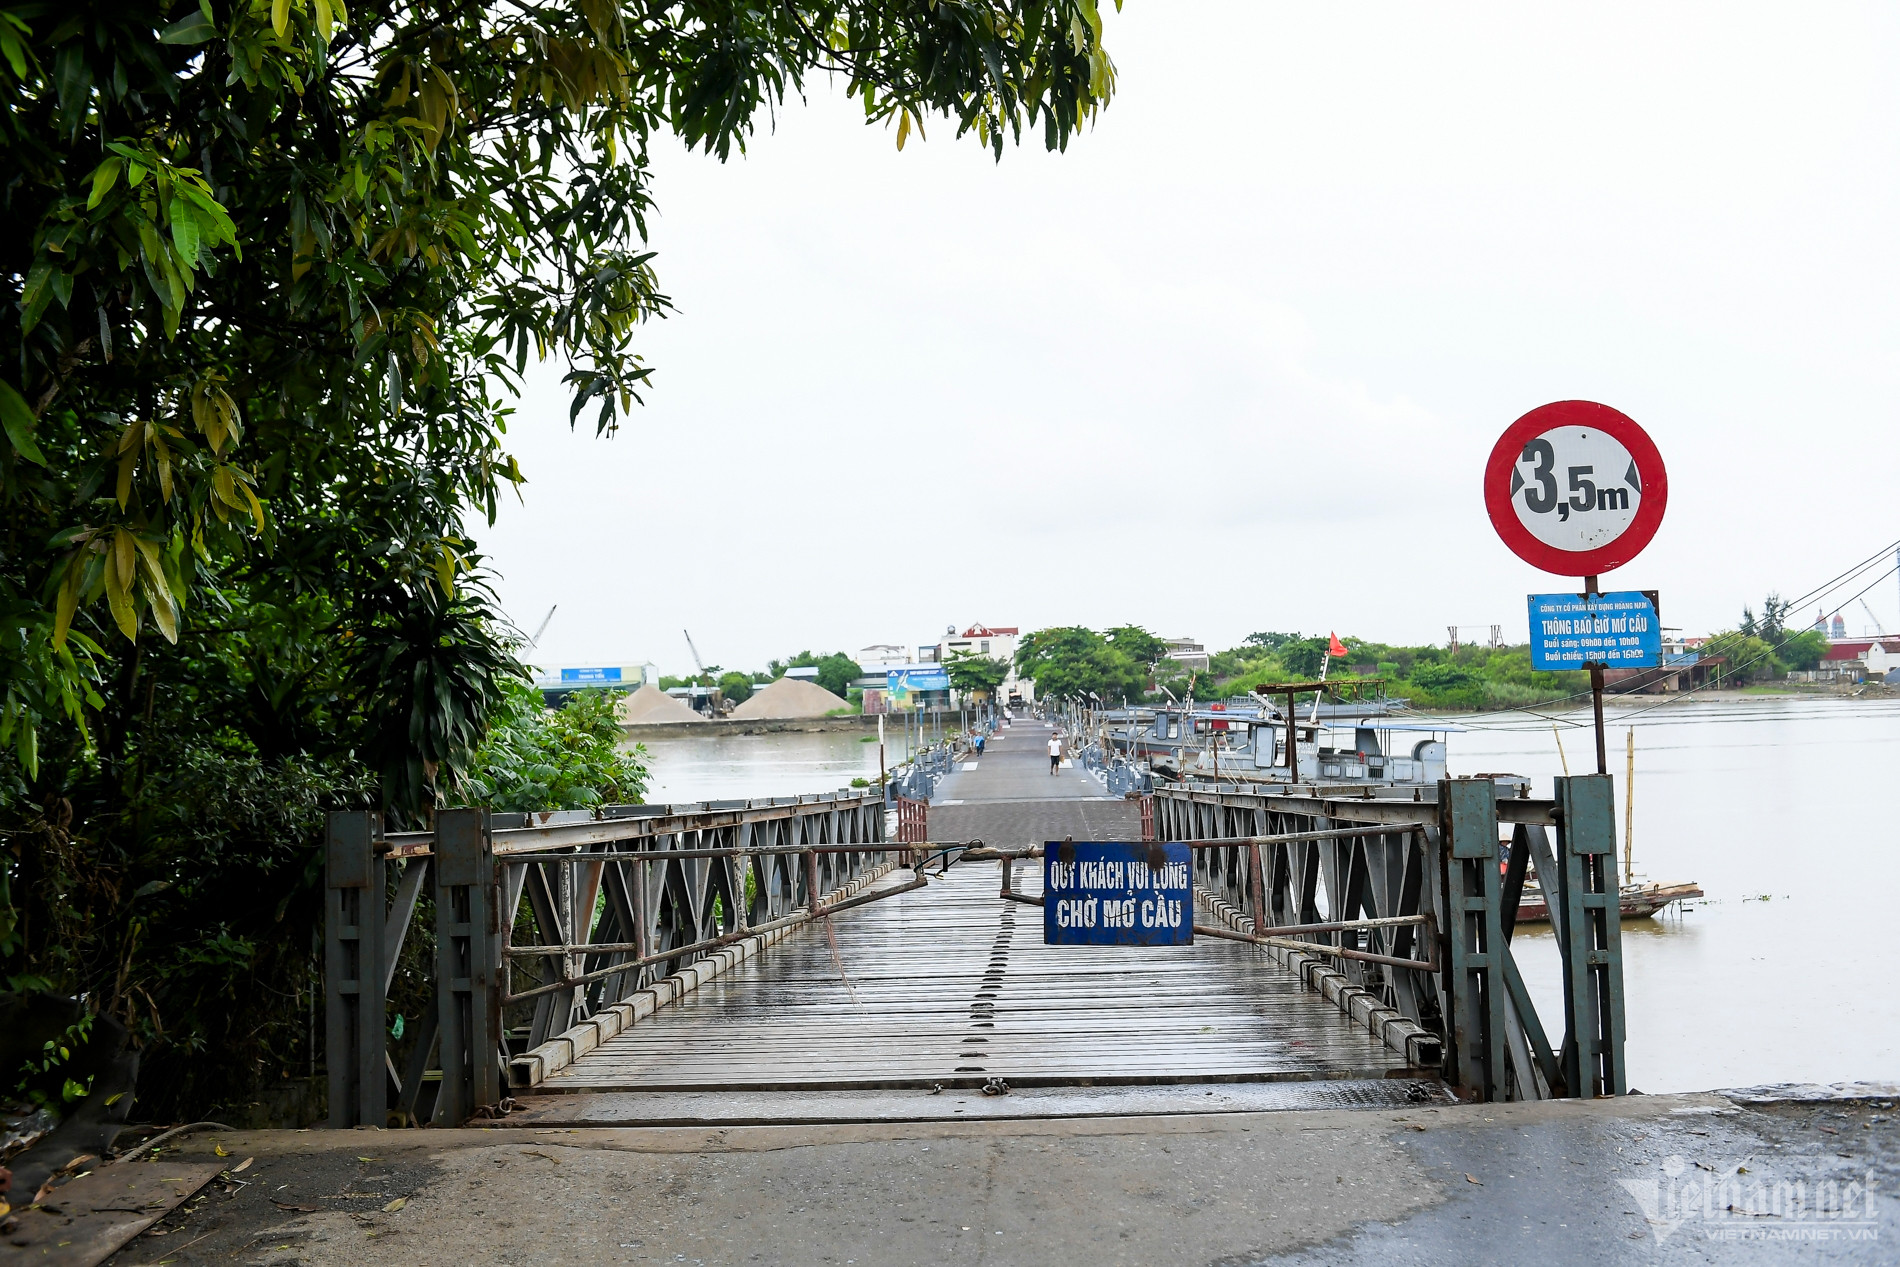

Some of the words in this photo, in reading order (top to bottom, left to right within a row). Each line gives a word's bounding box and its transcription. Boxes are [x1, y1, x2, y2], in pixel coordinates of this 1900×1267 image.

[1522, 438, 1629, 522] 3,5m
[1542, 617, 1571, 635] THÔNG
[1574, 616, 1591, 634] BÁO
[1595, 615, 1609, 633] GIỜ
[1612, 612, 1627, 632] MỞ
[1629, 613, 1647, 632] CẦU
[1561, 638, 1579, 648] sáng:
[1581, 638, 1601, 647] 09h00
[1604, 636, 1616, 646] đến
[1619, 637, 1639, 645] 10h00
[1586, 650, 1605, 659] 15h00
[1608, 649, 1620, 659] đến
[1080, 856, 1124, 889] KHÁCH
[1127, 862, 1148, 889] VUI
[1057, 894, 1098, 927] CHỜ
[1104, 890, 1136, 927] MỞ
[1142, 891, 1181, 927] CẦU
